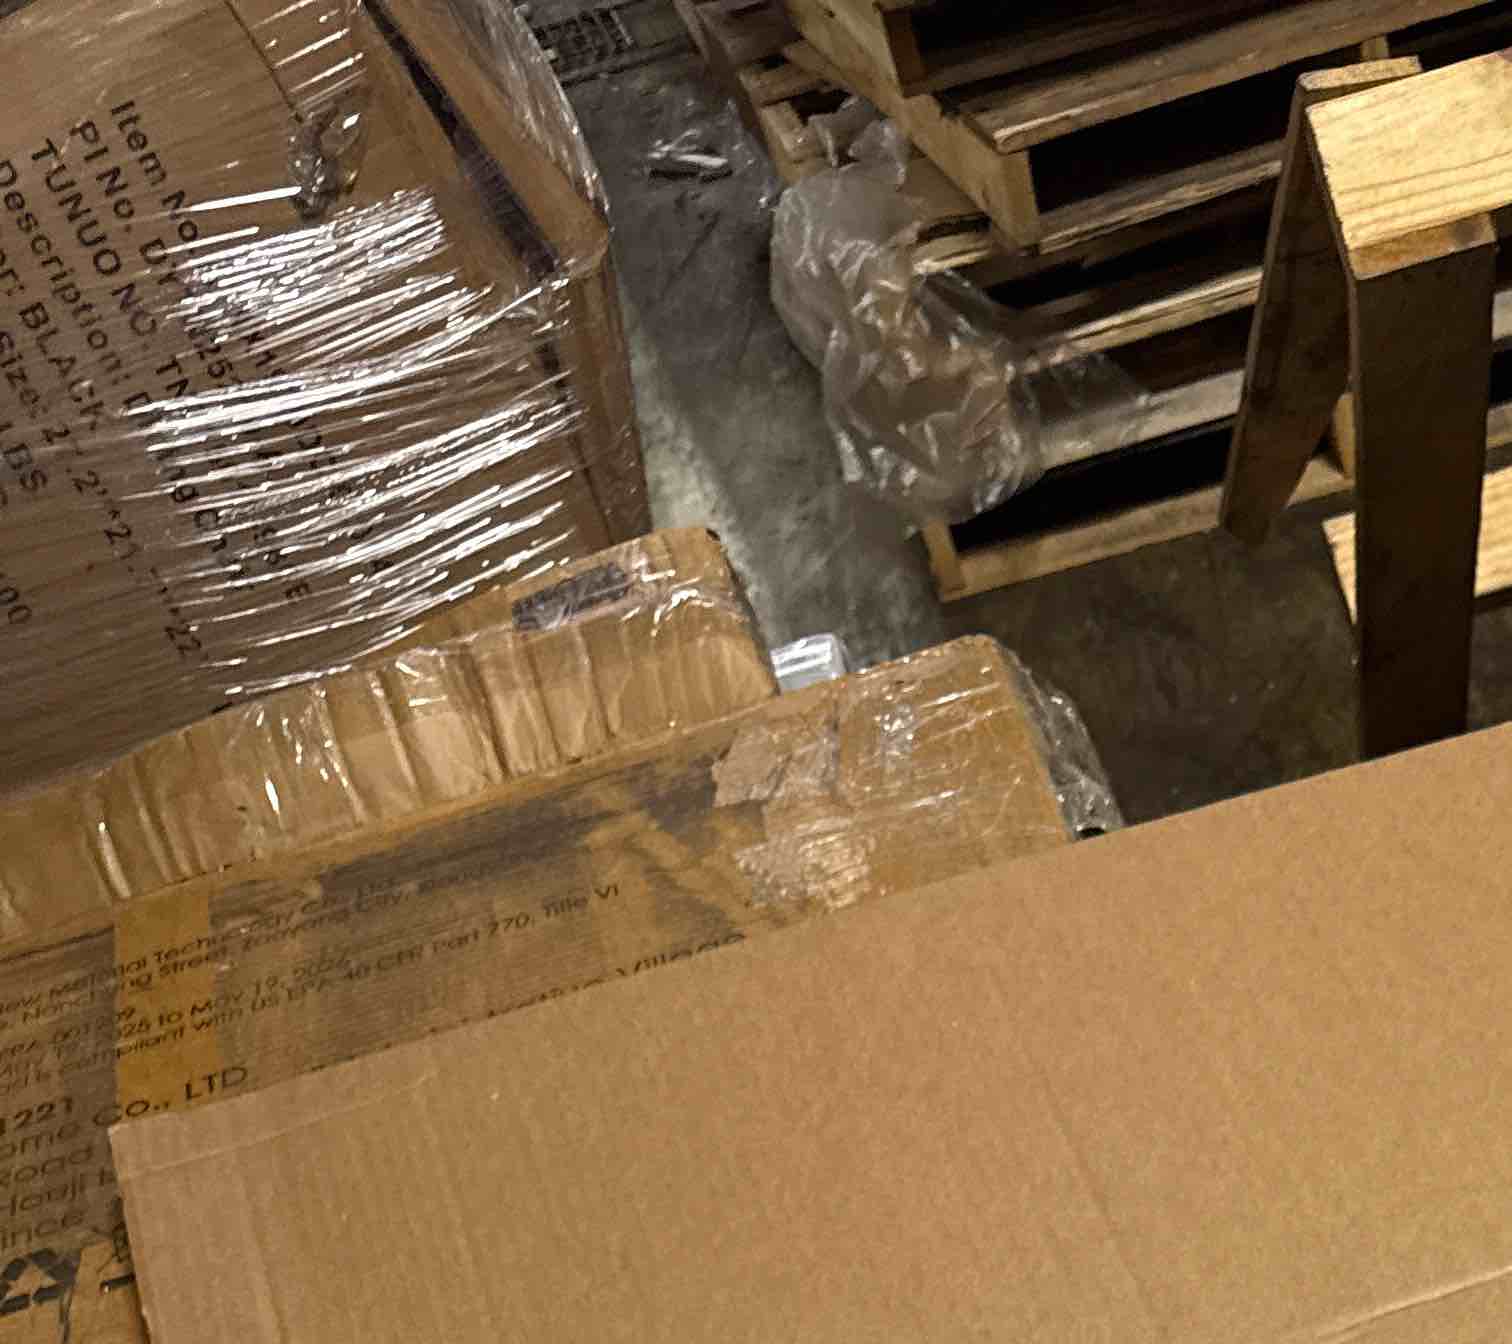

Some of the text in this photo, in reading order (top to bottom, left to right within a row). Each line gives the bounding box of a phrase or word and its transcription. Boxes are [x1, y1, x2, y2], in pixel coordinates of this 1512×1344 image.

[69, 120, 135, 233] PI No.
[110, 99, 167, 186] Item
[31, 137, 122, 276] TUNUO
[0, 158, 133, 387] Description:
[183, 1065, 249, 1101] LTD
